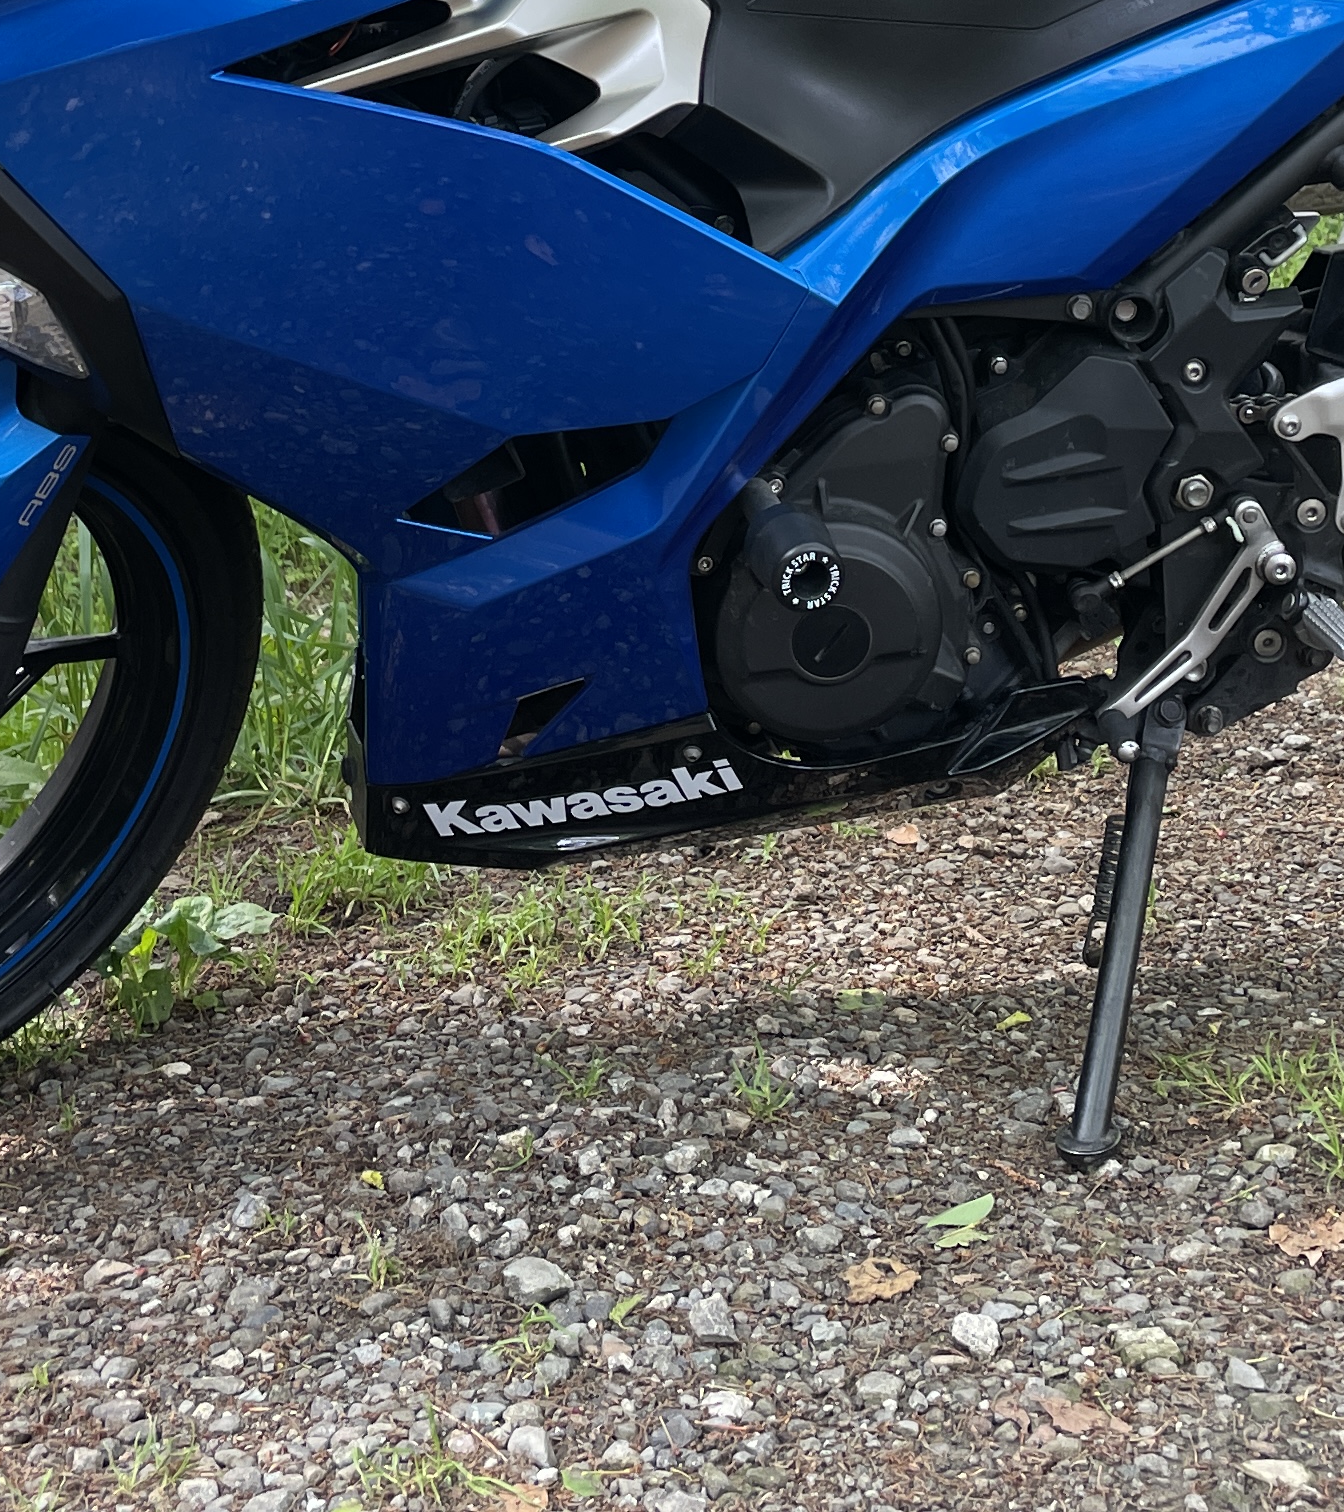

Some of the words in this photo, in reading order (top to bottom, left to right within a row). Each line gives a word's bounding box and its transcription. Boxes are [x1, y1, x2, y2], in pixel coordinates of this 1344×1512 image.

[18, 443, 77, 527] ABS
[781, 565, 794, 596] TRICK
[791, 551, 816, 569] STAR
[828, 564, 840, 594] TRICK
[807, 592, 832, 609] STAR
[423, 758, 743, 837] Kawasaki
